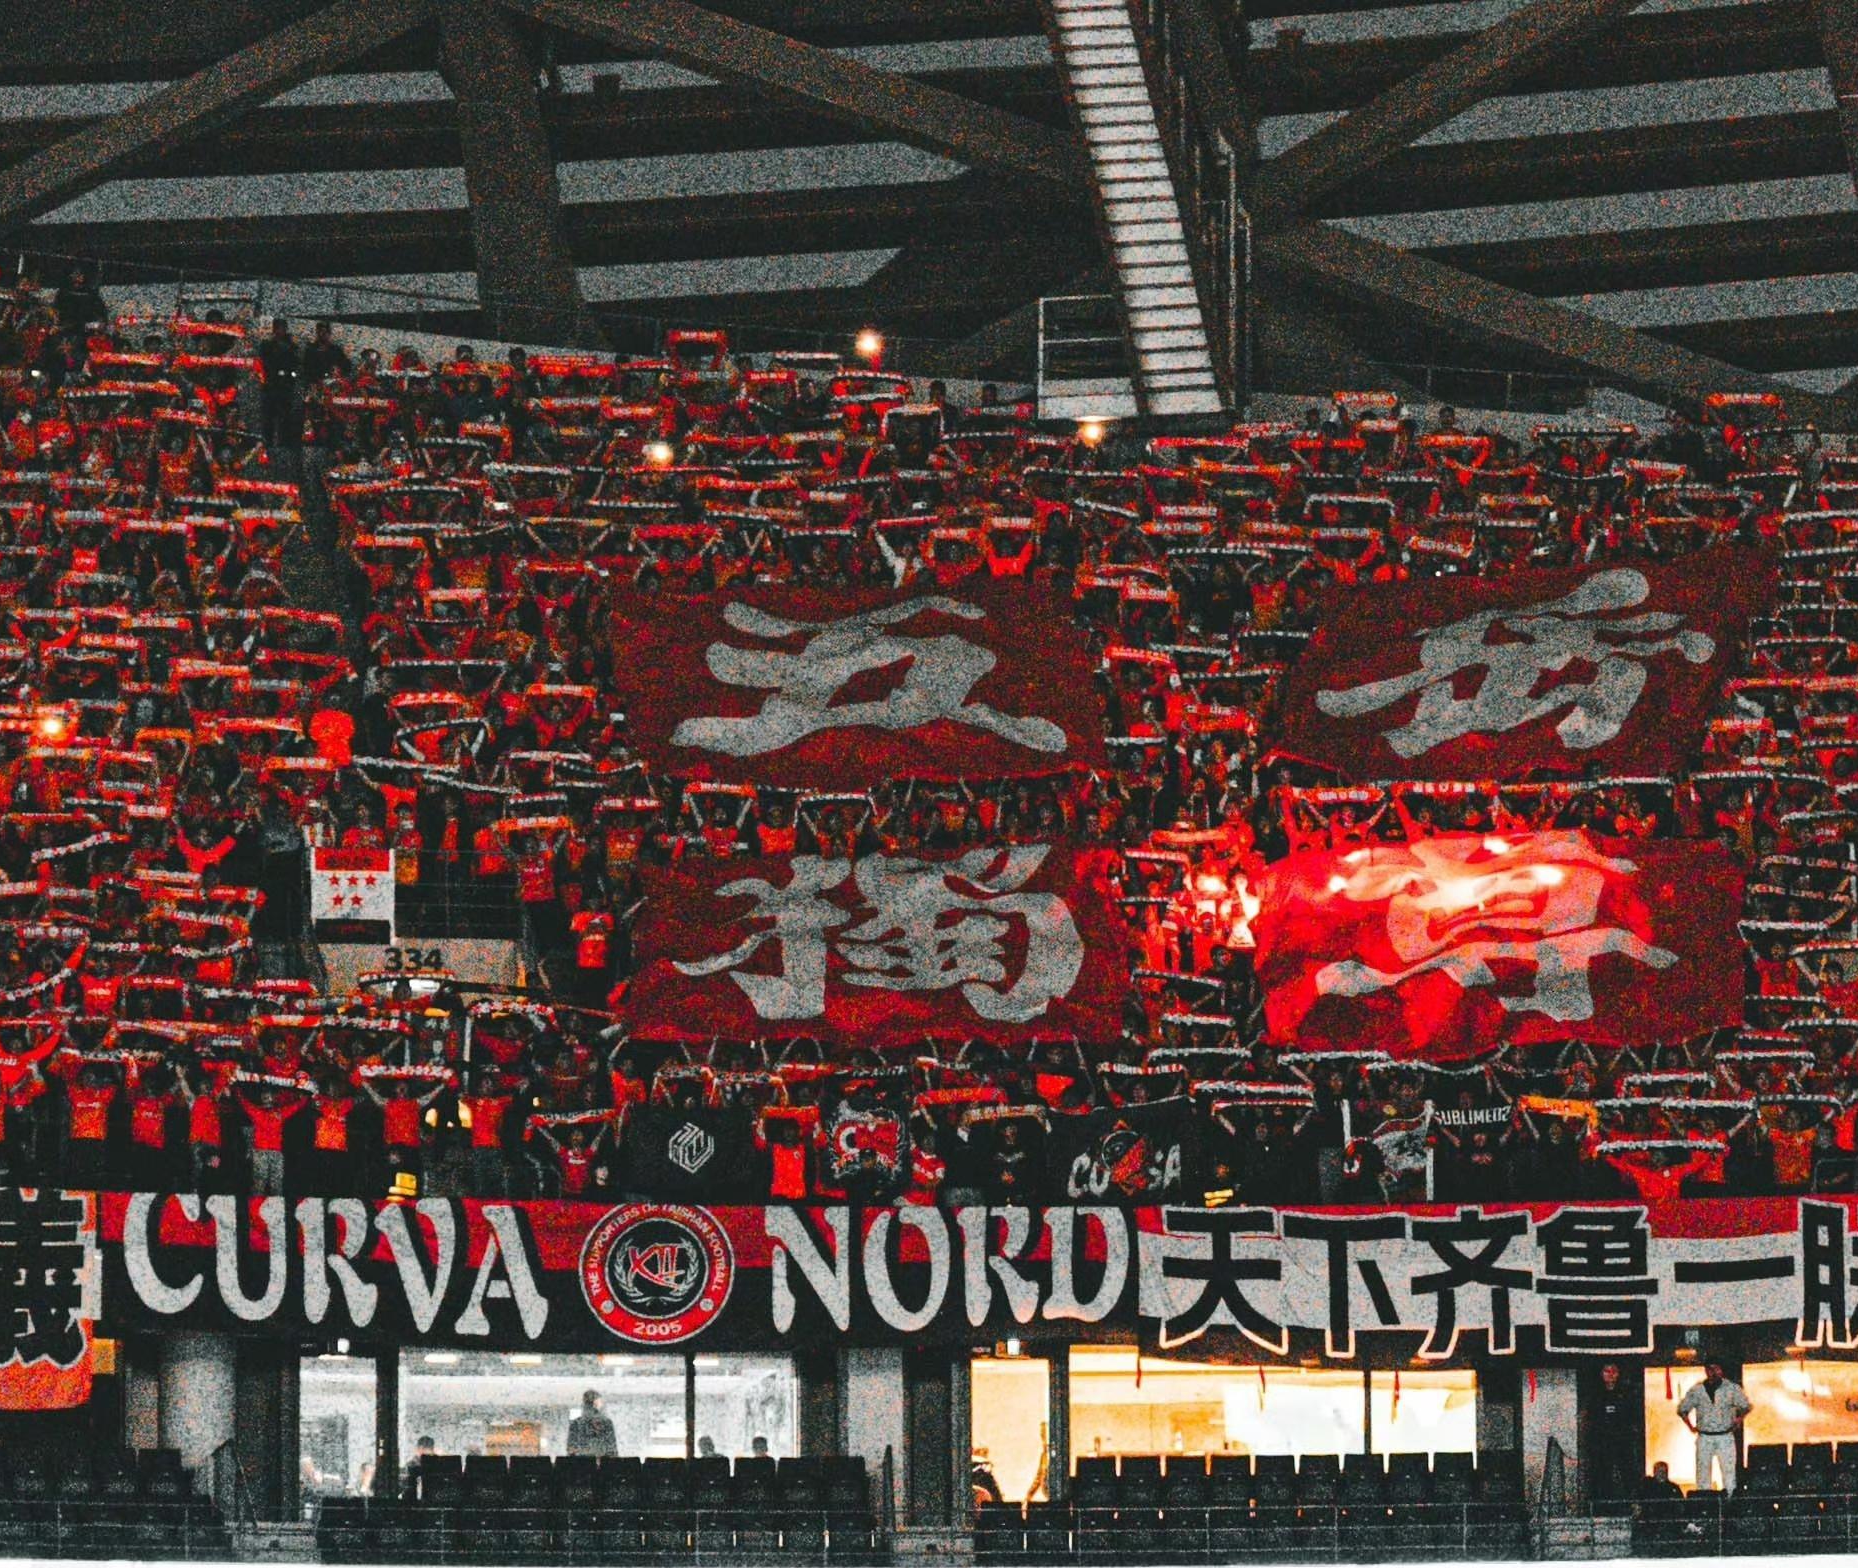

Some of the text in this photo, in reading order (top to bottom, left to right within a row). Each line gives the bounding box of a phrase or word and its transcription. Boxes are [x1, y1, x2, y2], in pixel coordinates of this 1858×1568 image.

[670, 596, 1069, 759] 五
[385, 948, 443, 970] 334
[123, 1191, 1130, 1341] CURVA NORD
[633, 1321, 683, 1336] 2005
